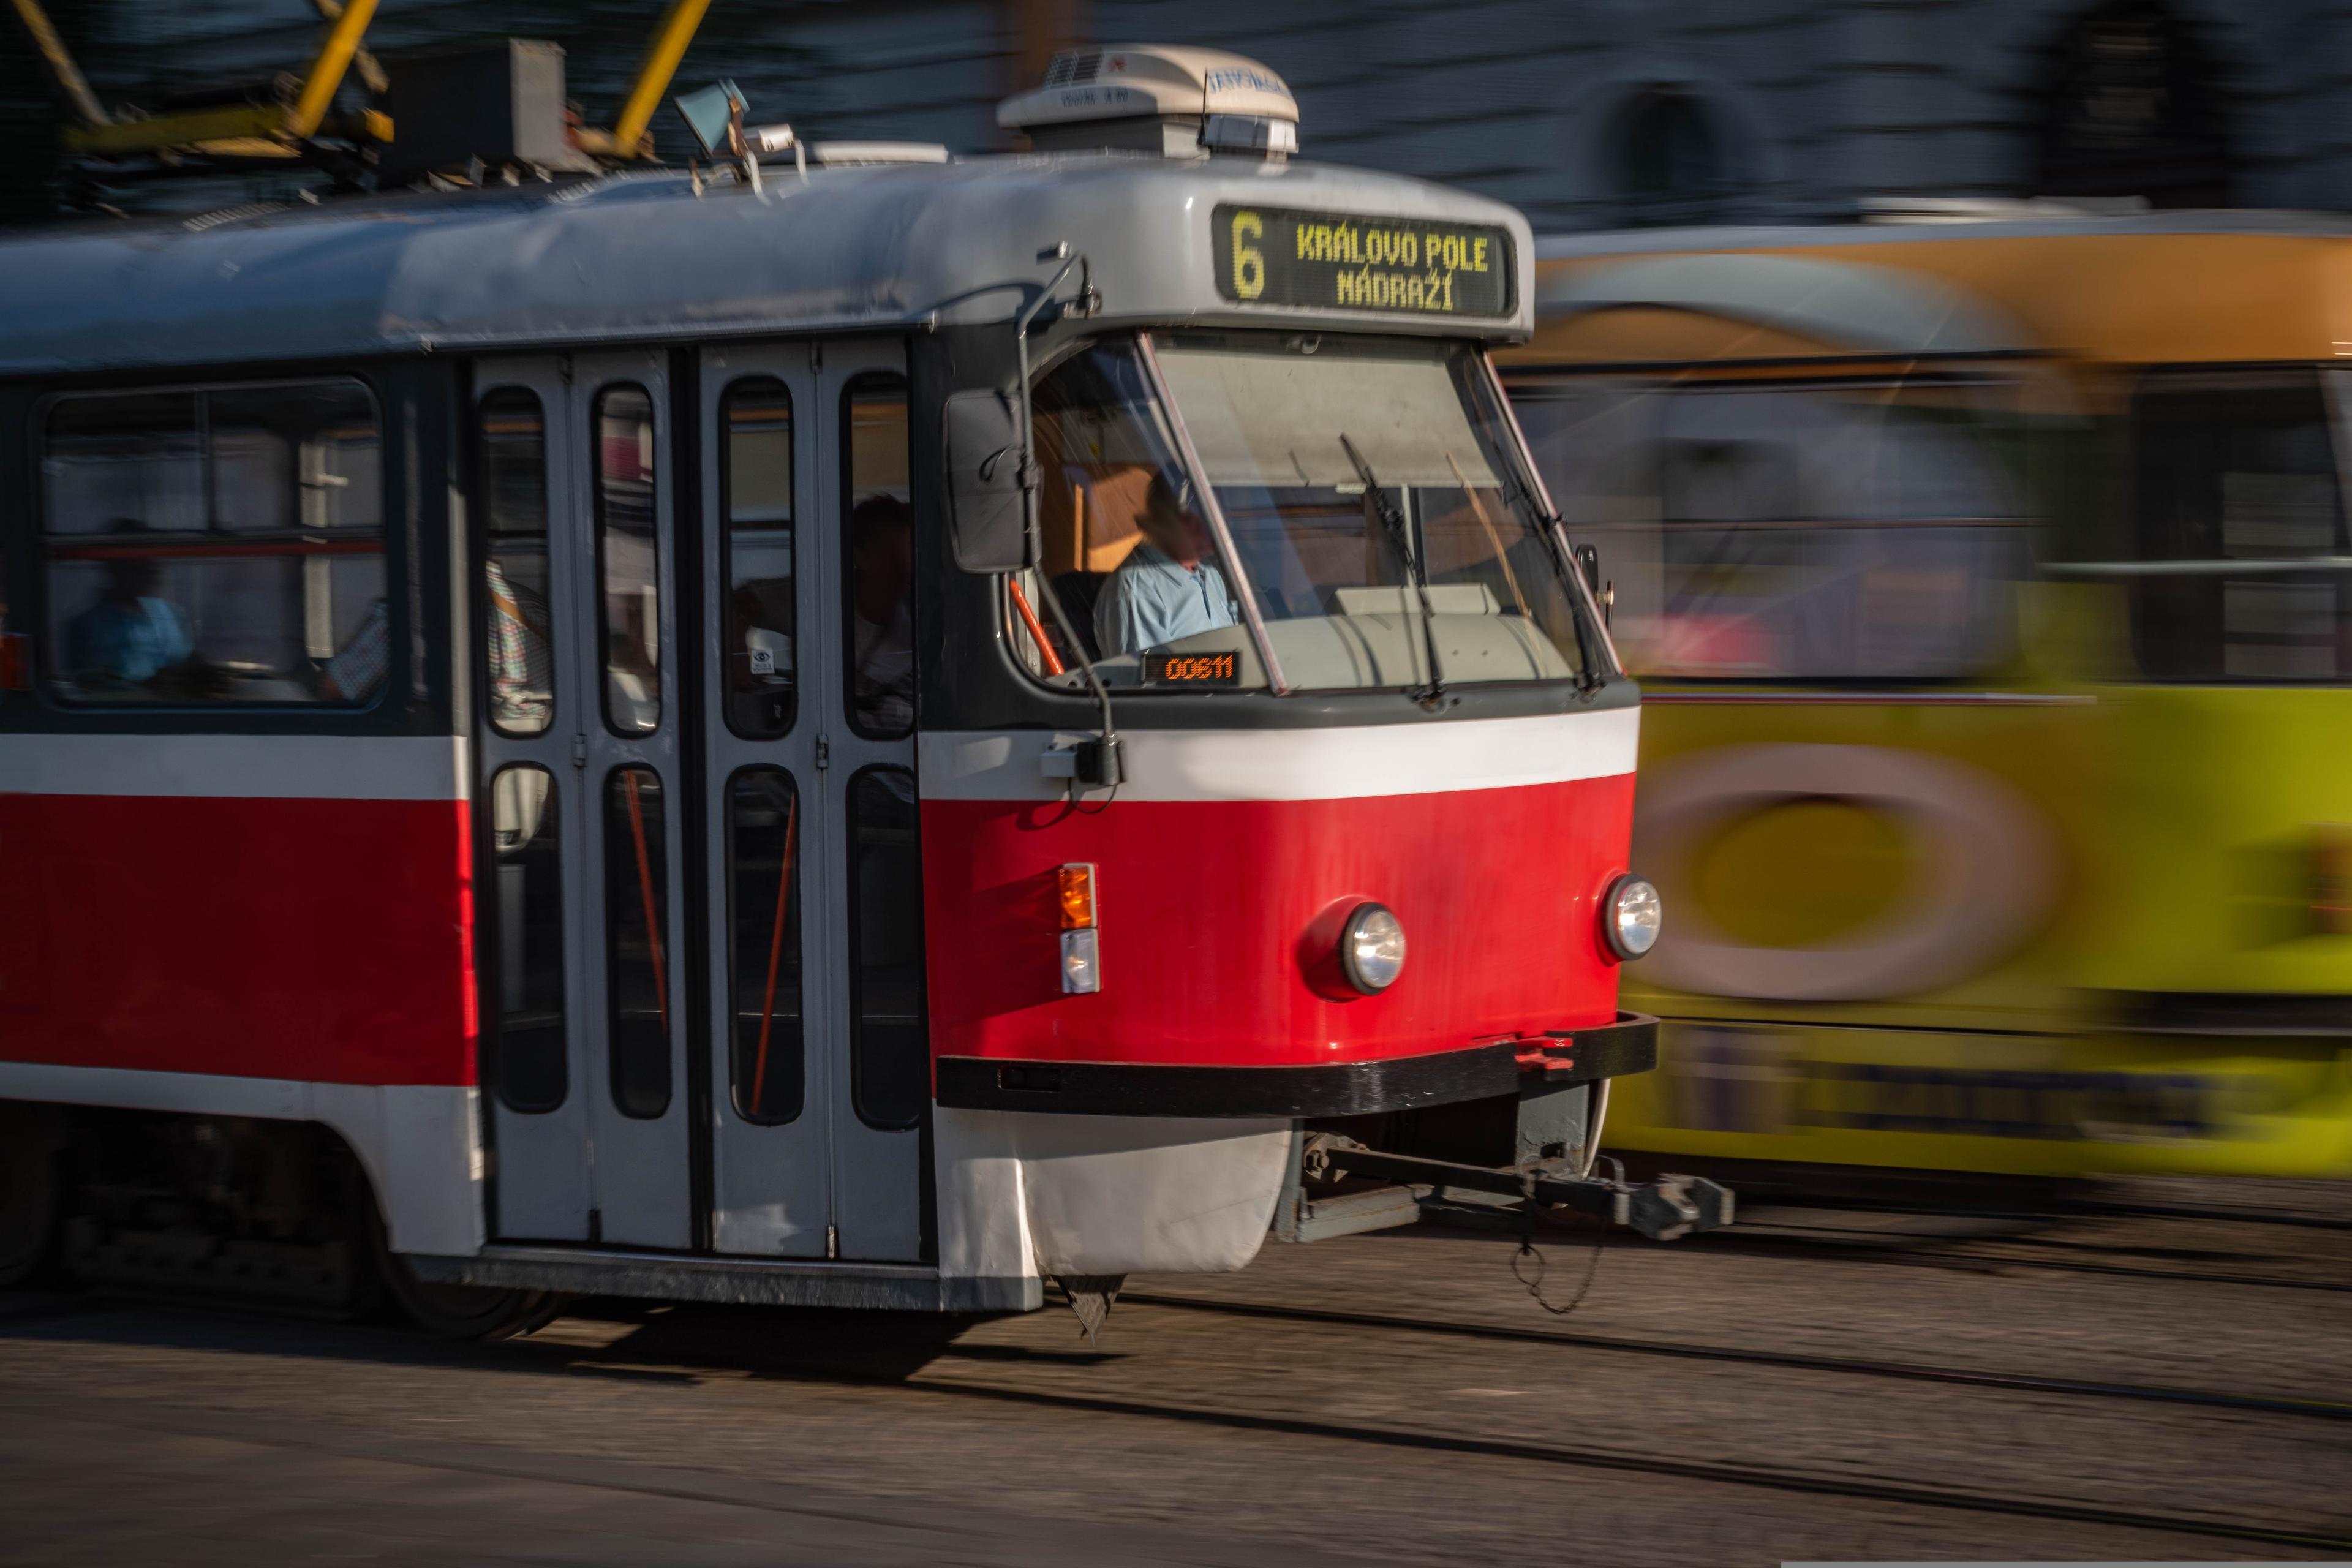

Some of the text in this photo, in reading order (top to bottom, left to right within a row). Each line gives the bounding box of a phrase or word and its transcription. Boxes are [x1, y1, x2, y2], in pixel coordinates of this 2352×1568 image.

[1231, 211, 1265, 300] 6
[1296, 220, 1488, 272] KRÁLOVO POLE
[1336, 263, 1453, 311] NÁDRAŽÍ
[1165, 654, 1233, 680] 00611
